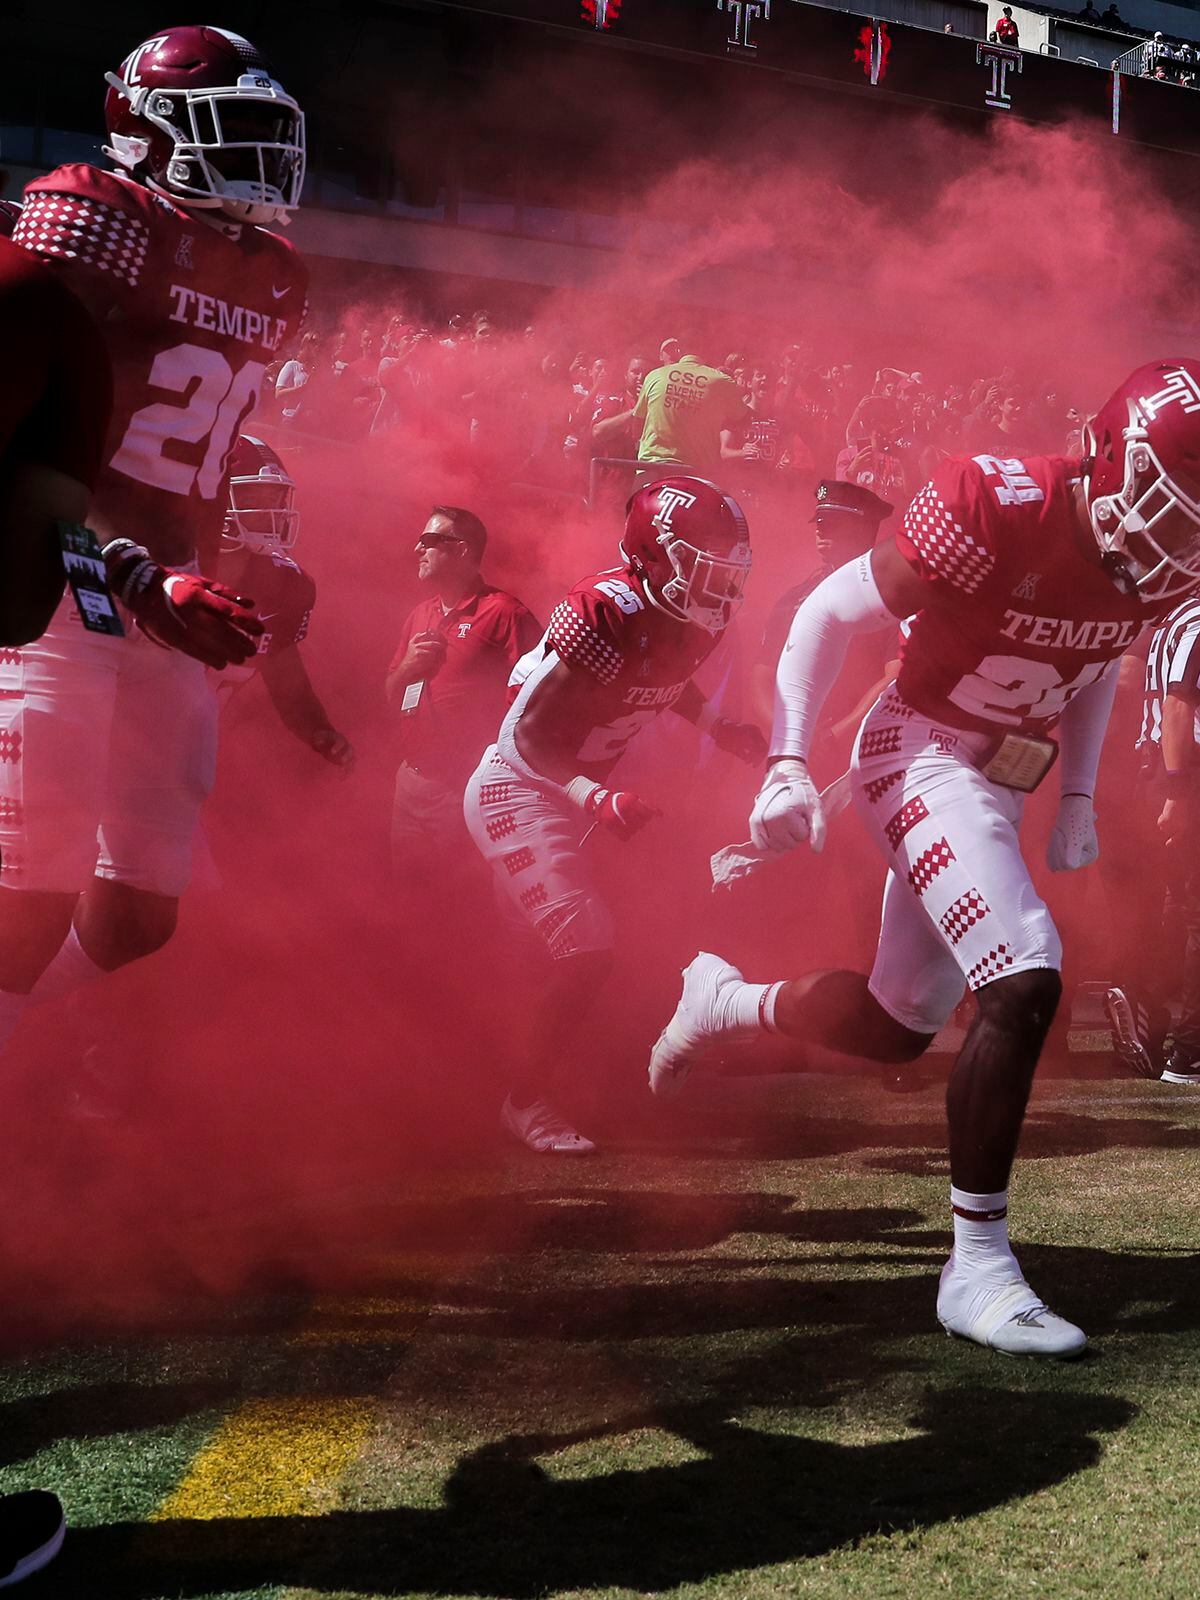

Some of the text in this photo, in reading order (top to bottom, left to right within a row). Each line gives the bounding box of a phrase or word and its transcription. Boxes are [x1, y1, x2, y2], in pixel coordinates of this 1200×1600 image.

[168, 284, 288, 351] TEMPLE
[665, 383, 705, 401] EVENT
[668, 370, 708, 389] CSC
[593, 578, 646, 616] 25
